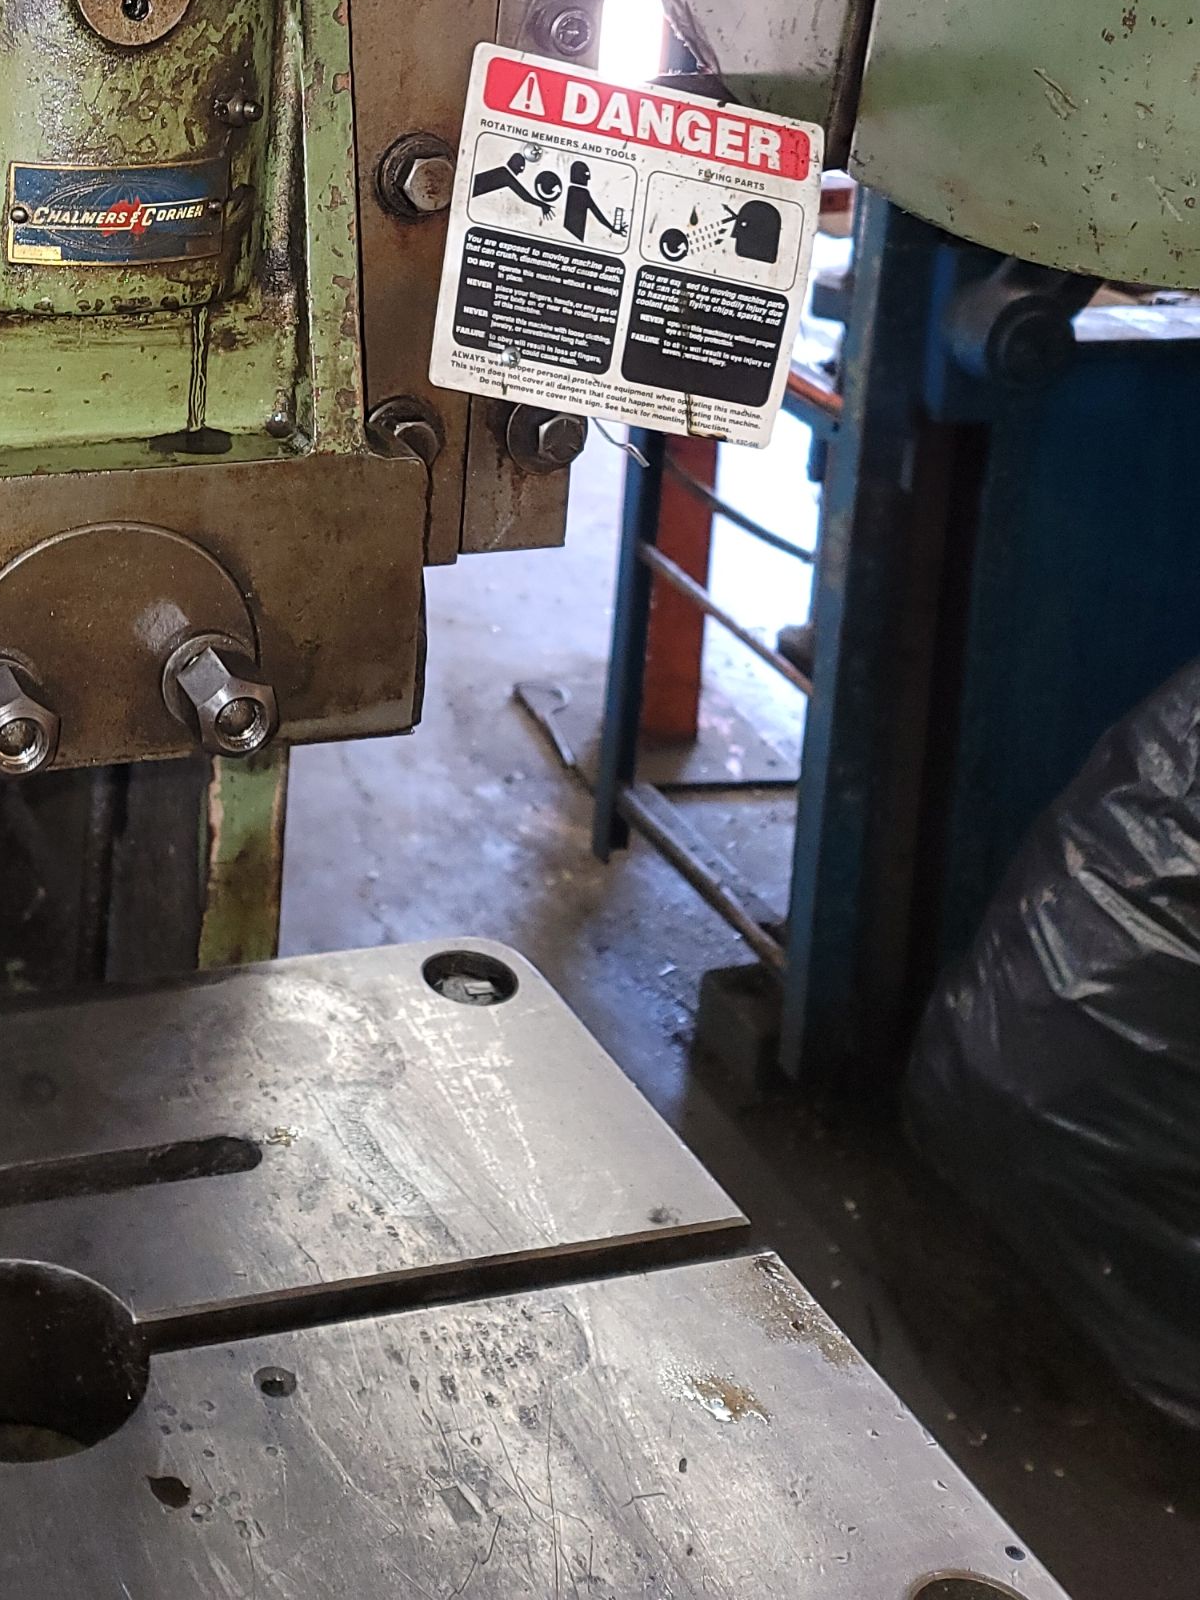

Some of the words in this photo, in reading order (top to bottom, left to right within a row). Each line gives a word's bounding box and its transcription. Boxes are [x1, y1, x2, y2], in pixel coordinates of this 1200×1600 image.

[480, 119, 528, 136] ROTATING
[531, 131, 578, 148] MEMBERS
[581, 143, 602, 153] AND
[605, 147, 636, 161] TOOLS
[562, 81, 781, 171] DANGER
[735, 177, 764, 190] PARTS
[32, 206, 128, 226] CHALMERS
[142, 204, 204, 226] CORNER
[468, 234, 482, 243] You
[451, 360, 467, 369] This
[469, 365, 485, 373] sign
[522, 377, 544, 385] cover
[557, 383, 586, 394] dangers
[589, 390, 604, 398] that
[606, 394, 627, 402] could
[628, 398, 655, 408] happen
[729, 419, 760, 429] machine.
[452, 350, 485, 363] ALWAYS
[536, 370, 568, 380] personal
[572, 377, 611, 389] protective
[614, 386, 653, 398] equipment
[656, 394, 674, 402] when
[714, 405, 727, 413] this
[479, 376, 489, 384] Do
[546, 392, 566, 400] cover
[569, 396, 582, 404] this
[585, 400, 602, 408] sign.
[605, 402, 618, 411] See
[621, 406, 637, 415] back
[640, 409, 650, 417] for
[652, 413, 684, 425] mounting
